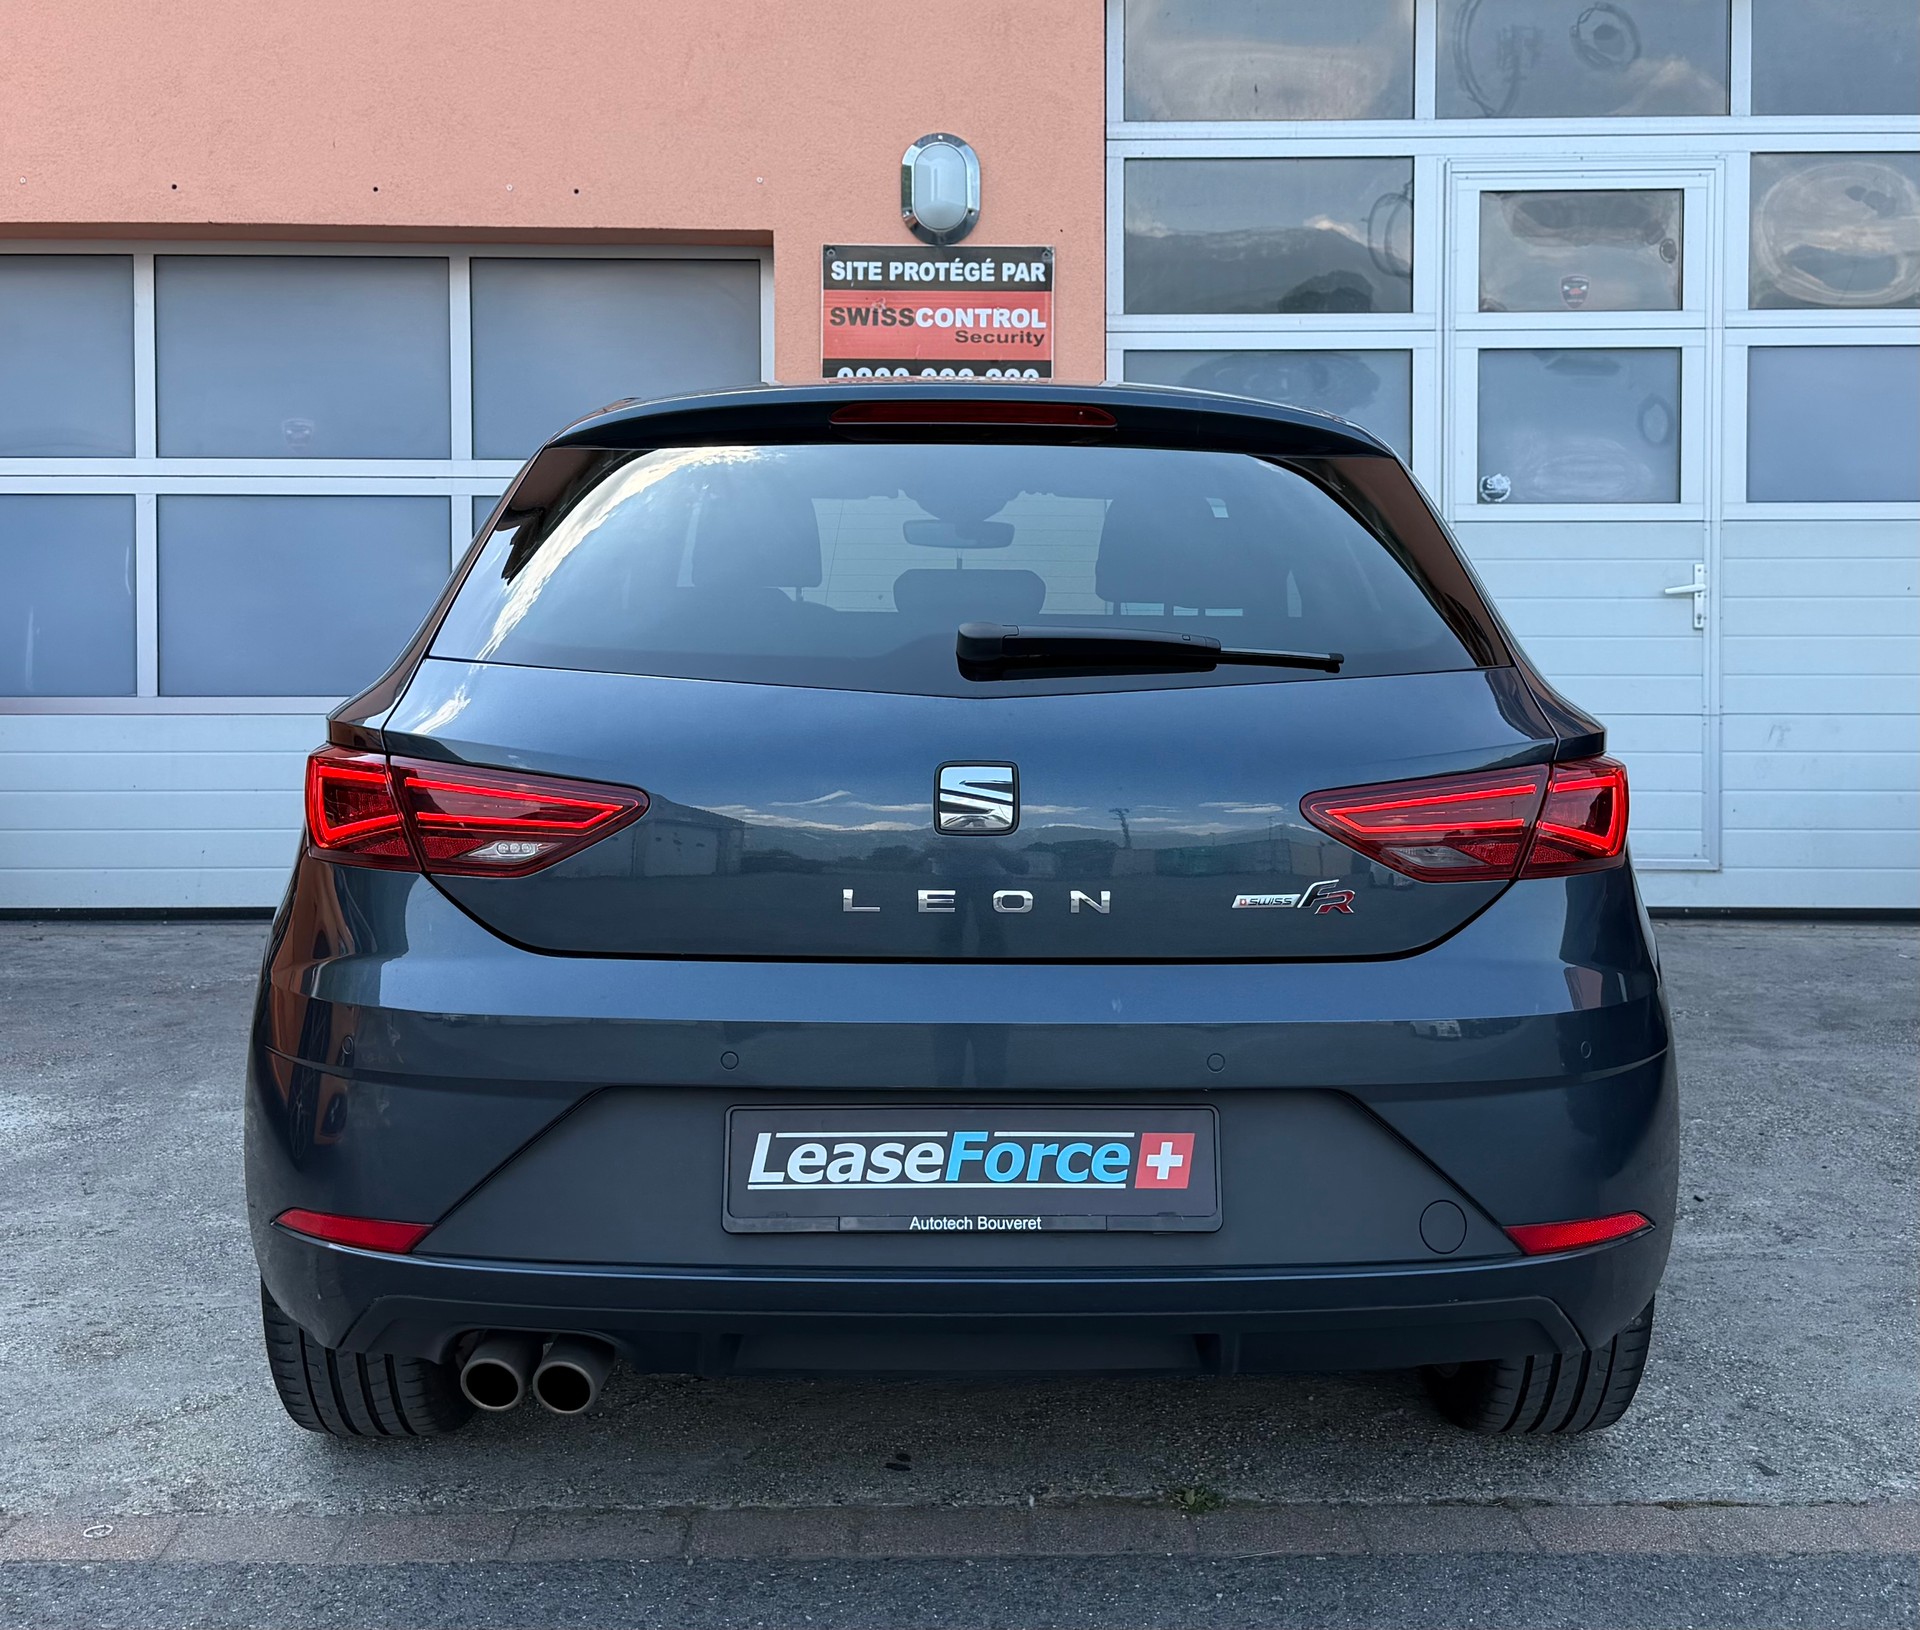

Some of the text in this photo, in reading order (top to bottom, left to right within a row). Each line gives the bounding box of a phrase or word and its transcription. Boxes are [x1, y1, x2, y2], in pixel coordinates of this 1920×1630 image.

[831, 258, 1046, 282] SITE PROTÉGÉ PAR
[955, 330, 1045, 347] Security
[842, 889, 1111, 915] LEON
[1248, 879, 1356, 915] SWISS FR
[748, 1131, 1130, 1183] LeaseForce
[909, 1216, 1042, 1231] Autotech Bouveret
